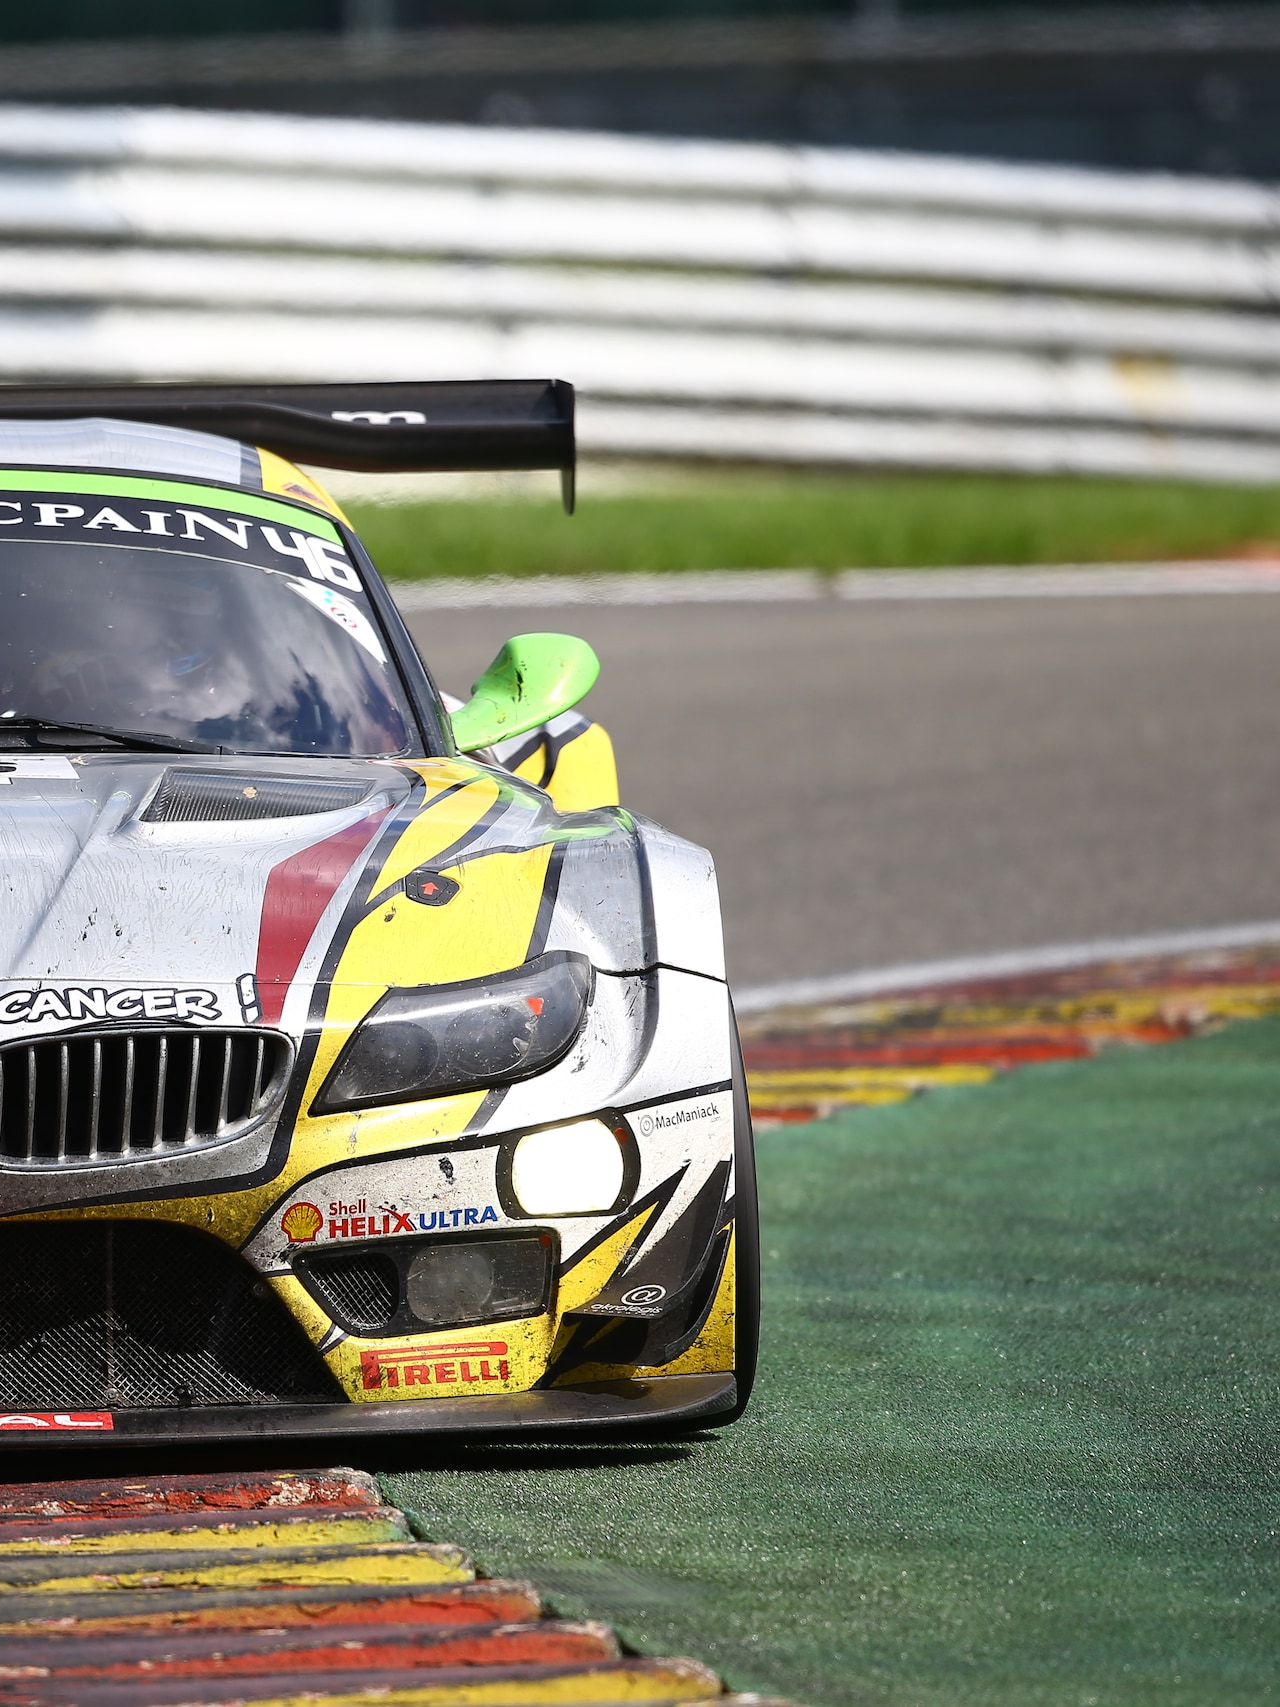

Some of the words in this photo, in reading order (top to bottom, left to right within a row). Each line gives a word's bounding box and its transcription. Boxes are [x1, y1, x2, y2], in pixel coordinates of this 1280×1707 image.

[260, 526, 363, 593] 46
[656, 1102, 719, 1129] MacManiack
[328, 1198, 367, 1216] Shell
[328, 1203, 417, 1239] HELIX
[419, 1206, 498, 1231] ULTRA
[360, 1341, 509, 1390] PIRELLI
